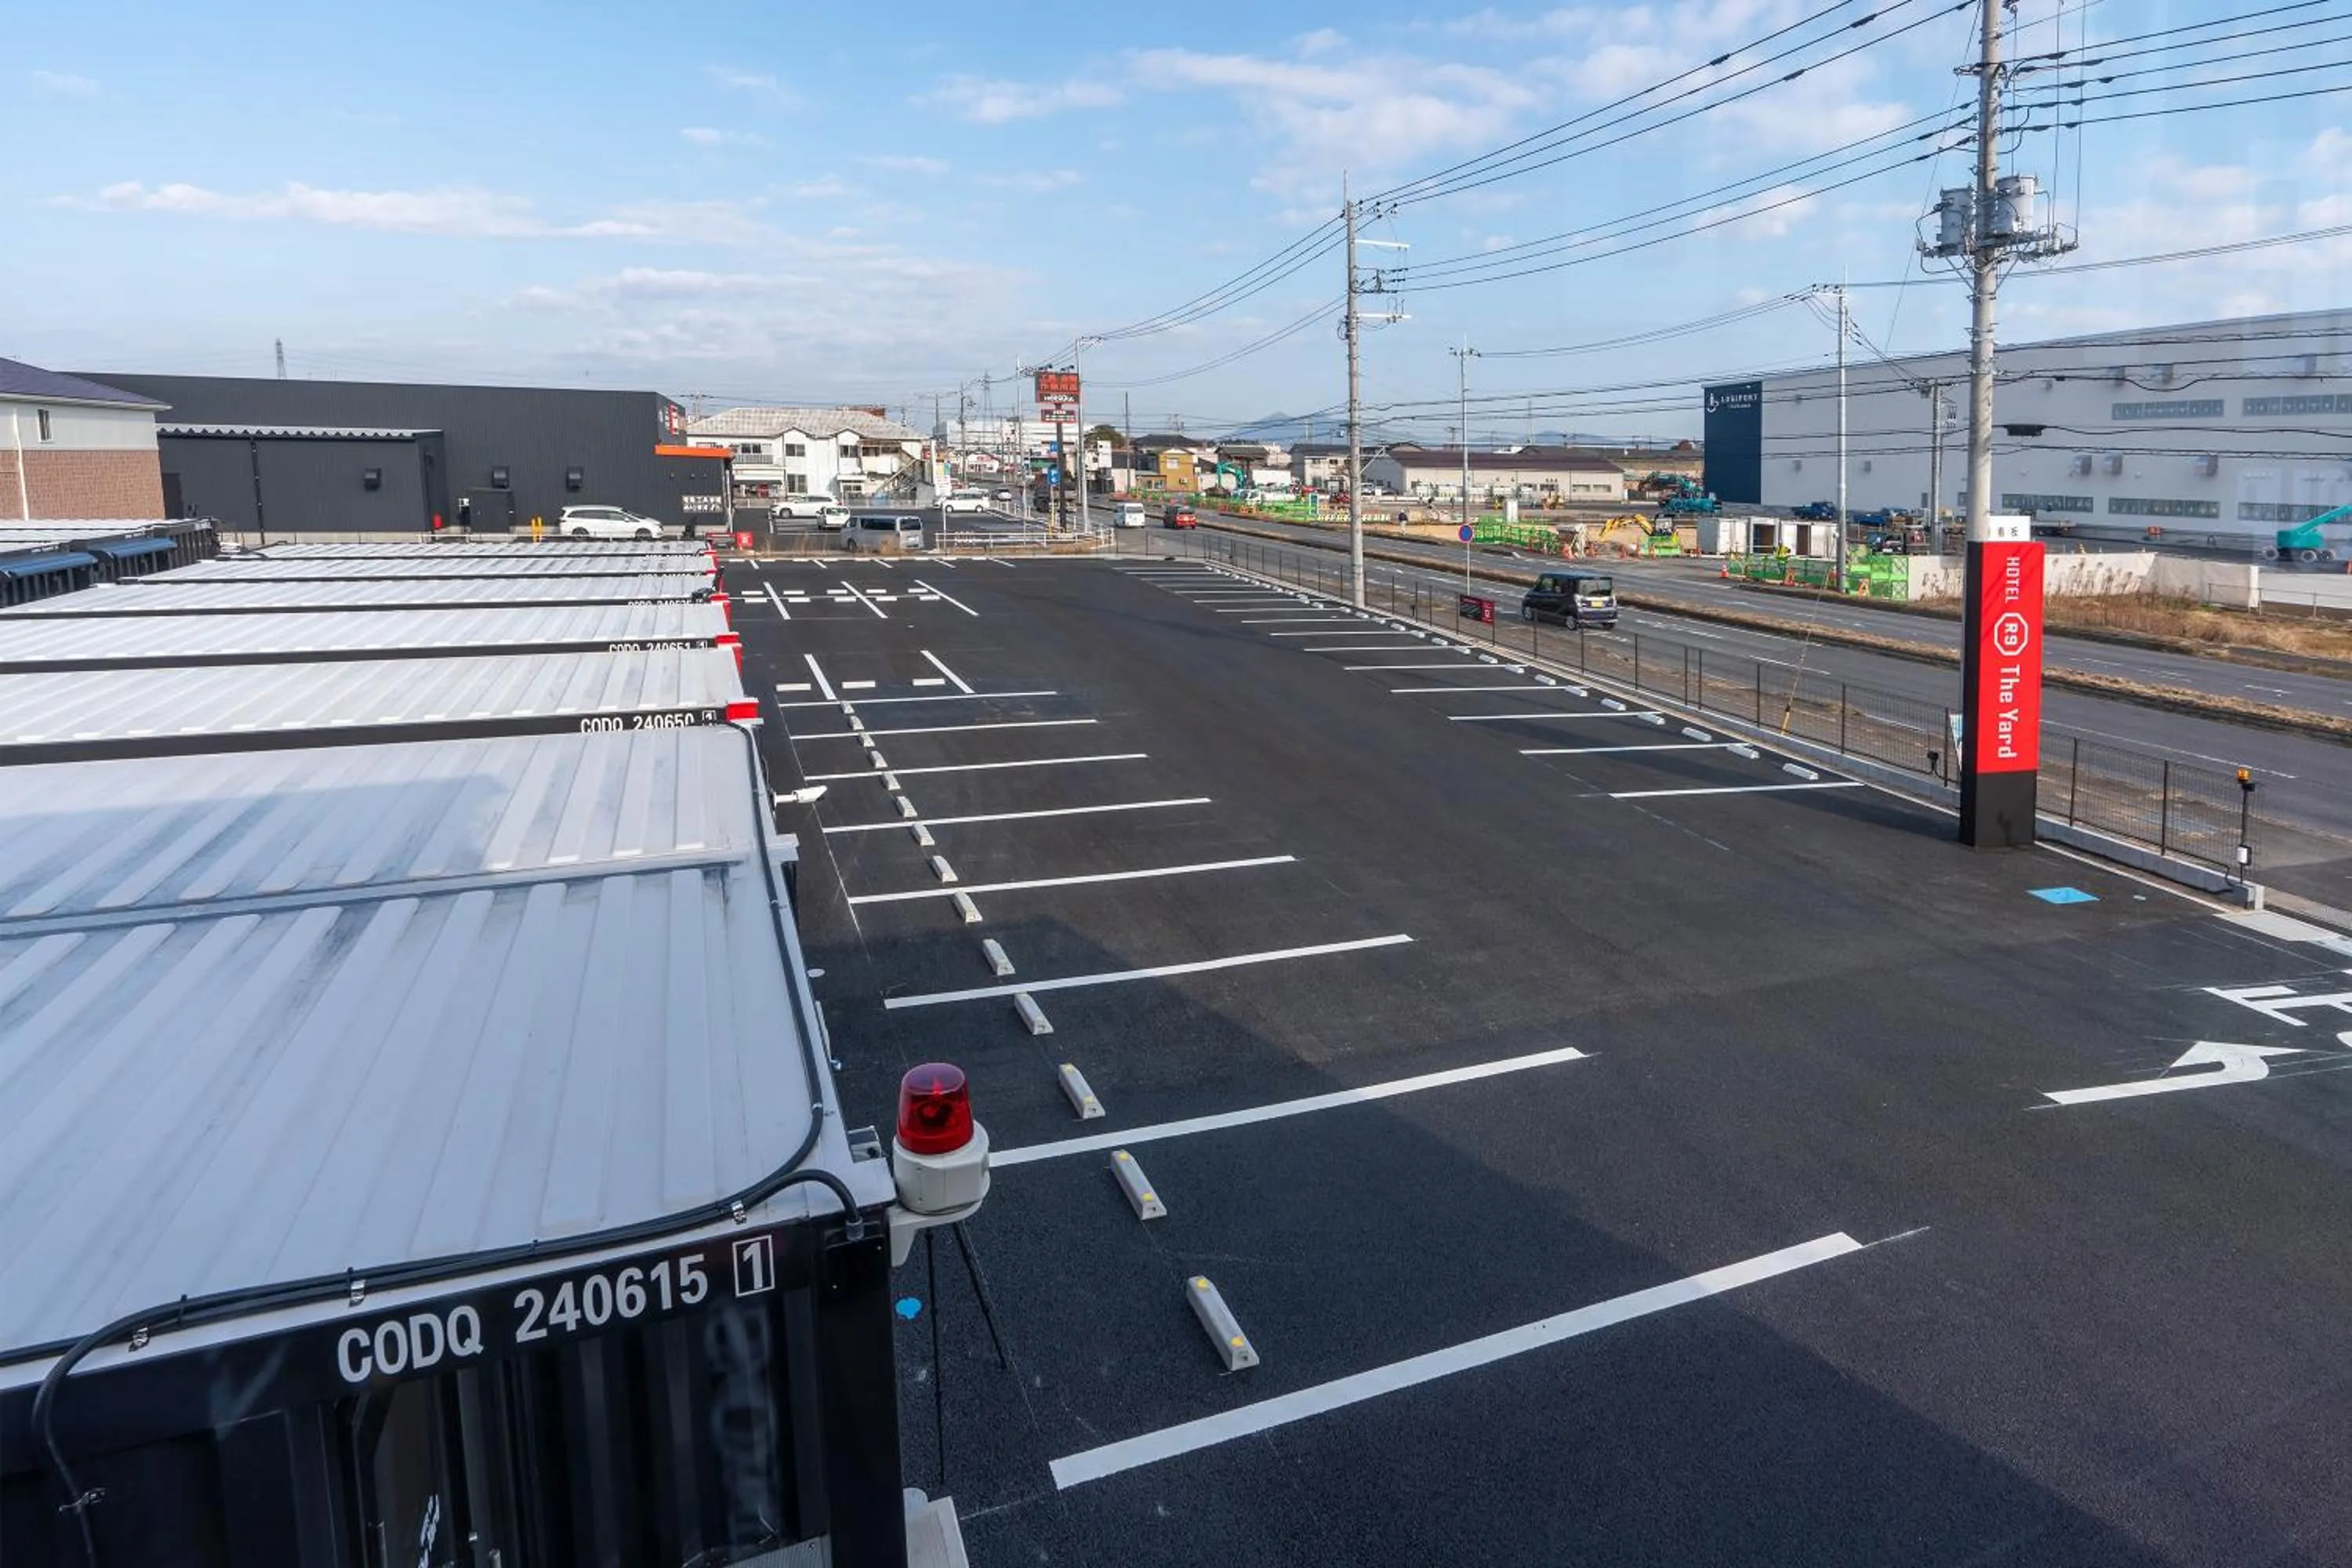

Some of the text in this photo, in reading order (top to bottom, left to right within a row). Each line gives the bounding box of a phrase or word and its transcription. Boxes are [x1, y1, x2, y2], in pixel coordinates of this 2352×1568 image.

[633, 712, 695, 730] 240650
[1997, 557, 2020, 758] HOTEL R9 The Yard
[337, 1241, 764, 1383] CODQ 240615 1
